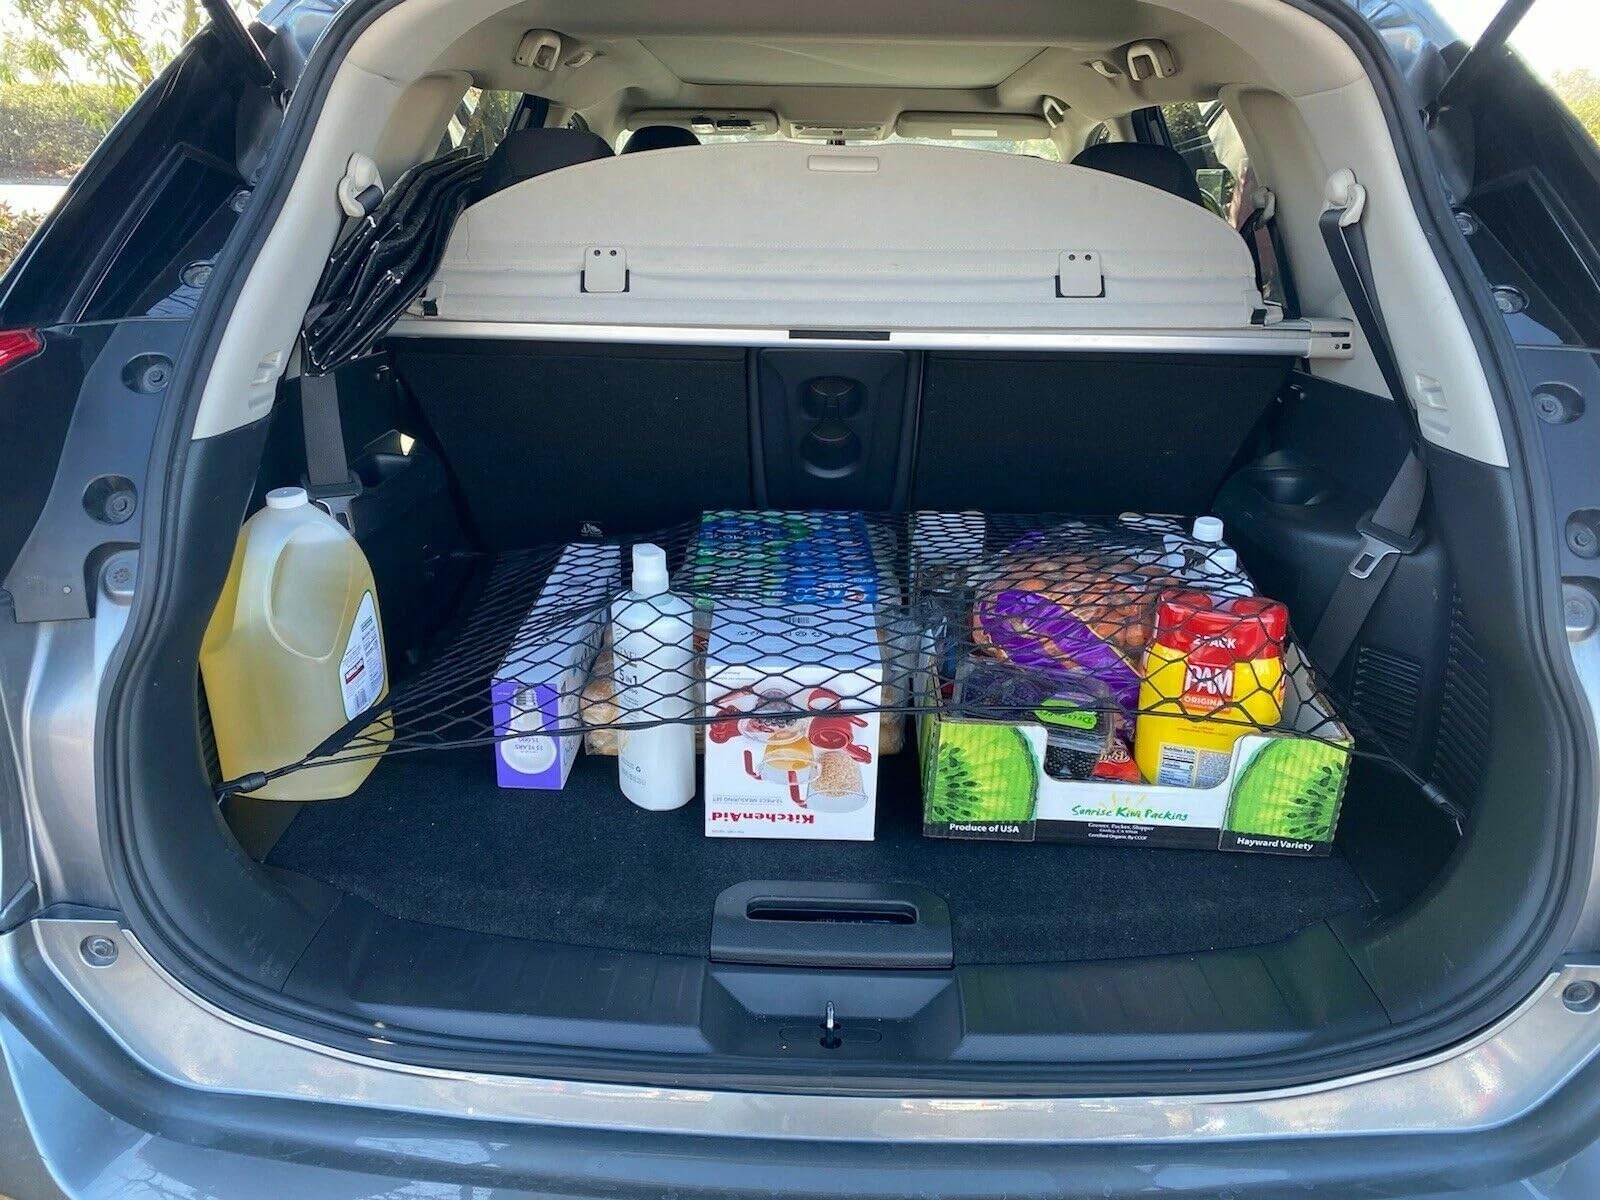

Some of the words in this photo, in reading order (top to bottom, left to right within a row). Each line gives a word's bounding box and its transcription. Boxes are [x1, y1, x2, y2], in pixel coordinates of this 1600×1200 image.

[1184, 665, 1233, 694] PAM
[1184, 696, 1225, 706] ORIGINA
[711, 811, 814, 824] KitchenAid
[1115, 806, 1141, 818] Kiwi
[1144, 808, 1188, 822] Packing
[949, 823, 987, 832] Produce
[1000, 825, 1020, 833] USA
[1237, 837, 1279, 847] Hayward
[1280, 840, 1313, 851] Variety
